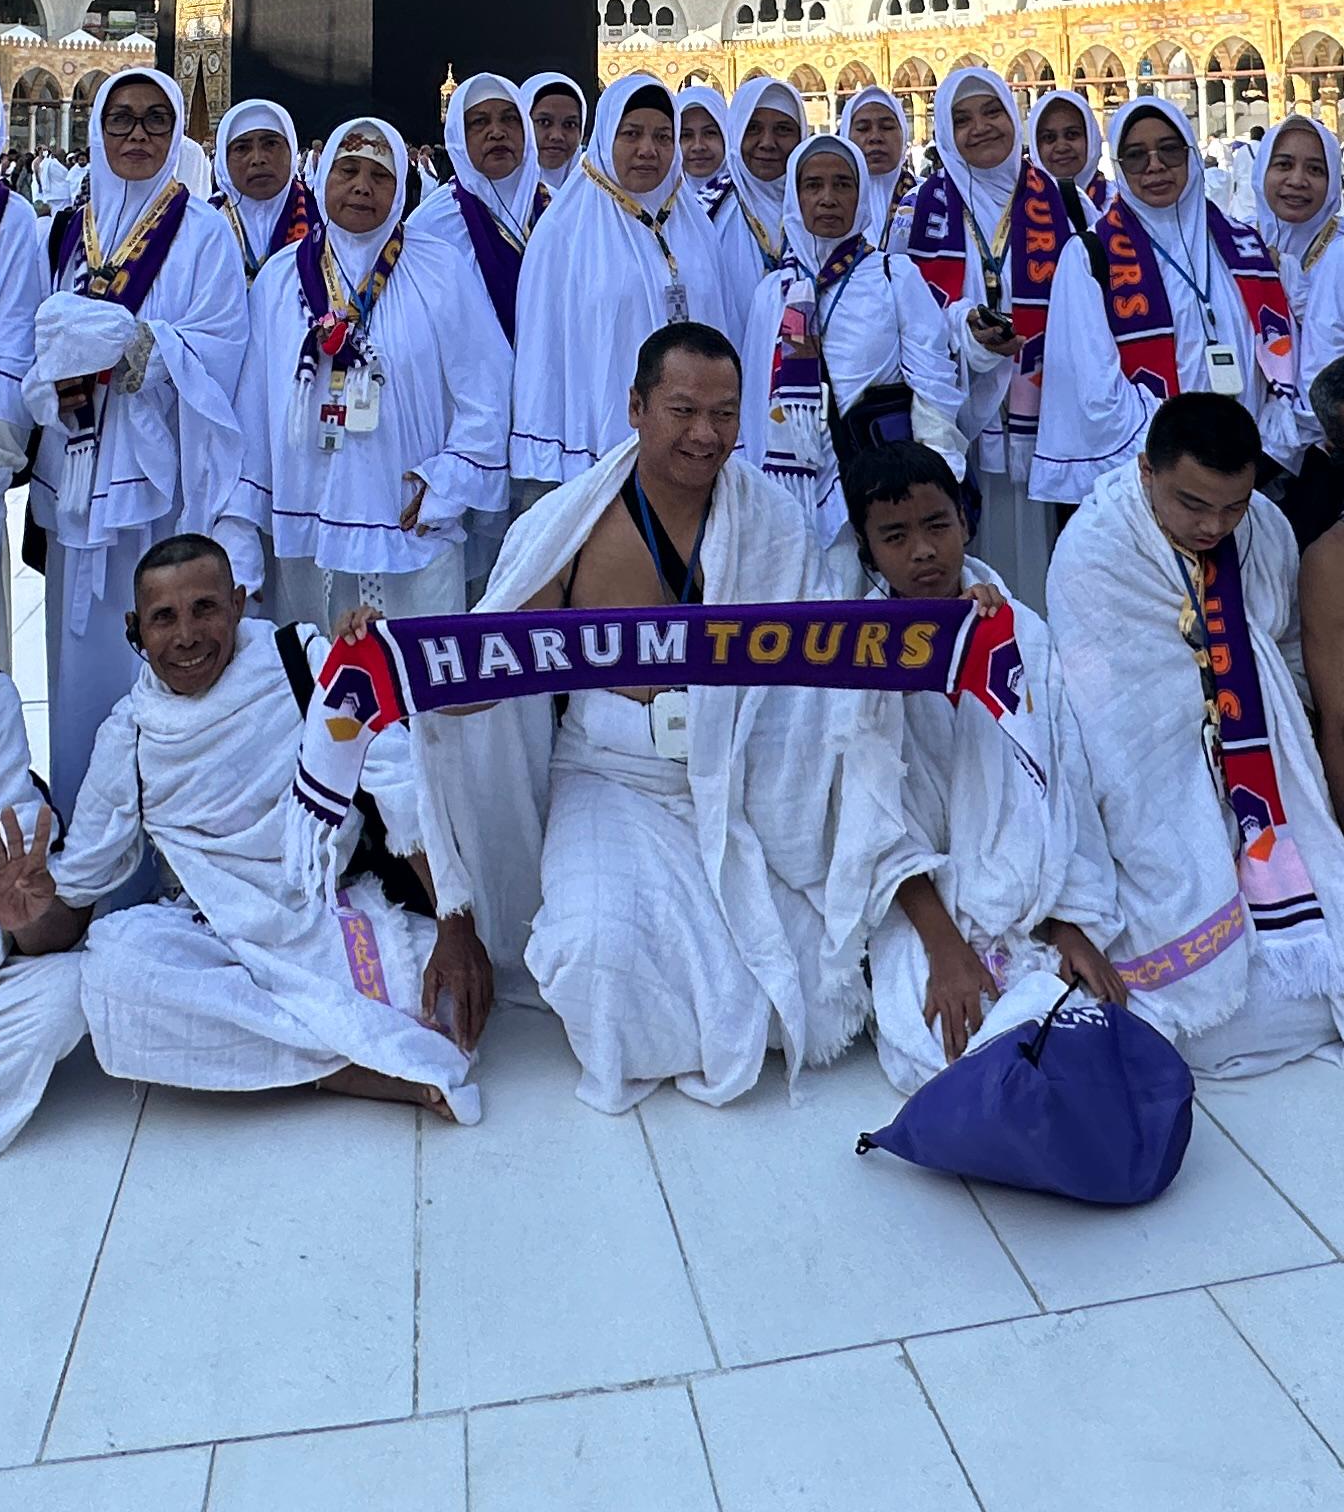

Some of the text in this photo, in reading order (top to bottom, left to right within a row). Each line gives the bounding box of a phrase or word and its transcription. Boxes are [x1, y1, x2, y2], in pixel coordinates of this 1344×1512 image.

[418, 620, 941, 687] HARUM TOURS
[1178, 906, 1244, 968] HARUM
